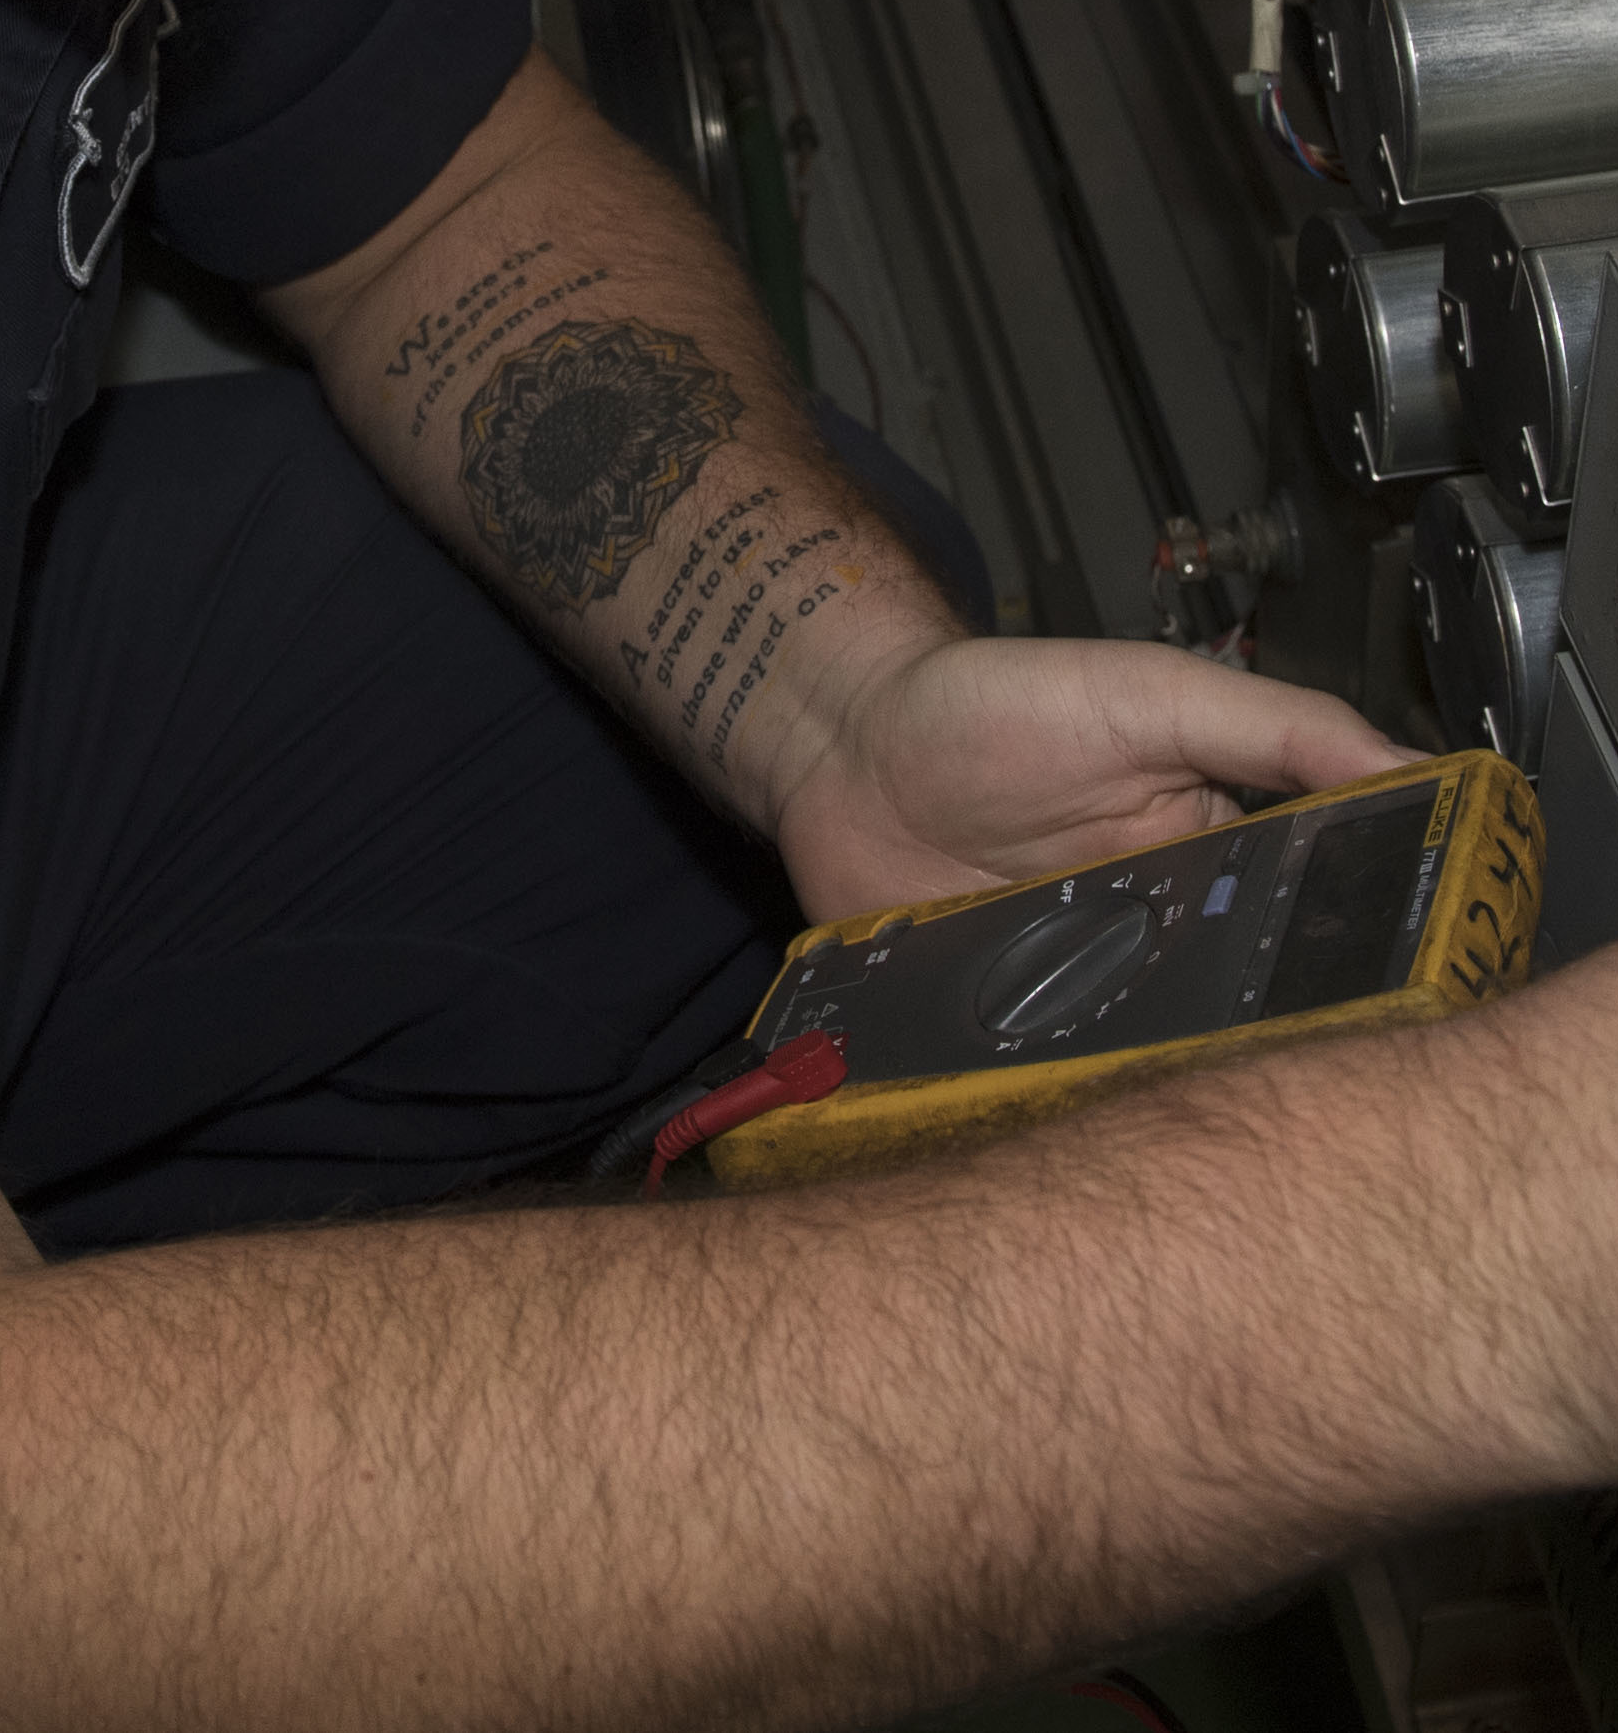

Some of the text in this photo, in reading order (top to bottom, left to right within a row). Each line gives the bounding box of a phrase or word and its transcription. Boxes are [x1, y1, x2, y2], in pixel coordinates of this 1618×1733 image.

[385, 241, 553, 376] We are the
[425, 363, 457, 404] the
[466, 267, 609, 365] memories
[426, 274, 526, 371] keepers
[620, 485, 783, 690] A sacred trust
[656, 606, 704, 690] given
[699, 569, 722, 601] to
[721, 582, 766, 646] who
[763, 528, 841, 579] have
[706, 581, 840, 775] journeyed on
[1428, 786, 1454, 842] FLUKE
[1059, 879, 1076, 904] OFF
[1259, 936, 1272, 950] 20
[1406, 874, 1431, 931] MULTIMETER
